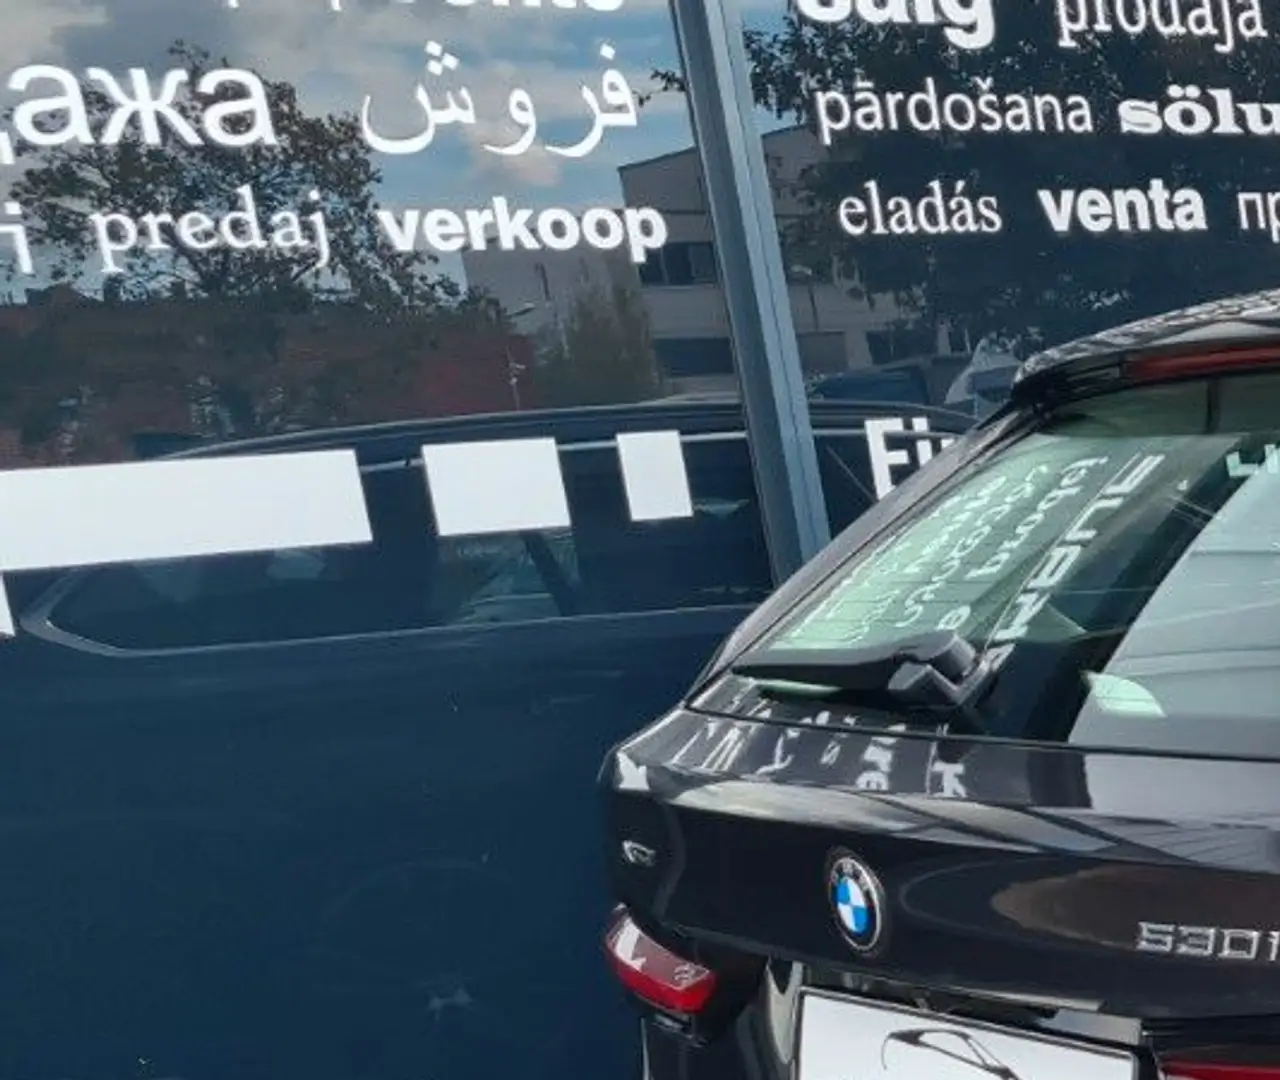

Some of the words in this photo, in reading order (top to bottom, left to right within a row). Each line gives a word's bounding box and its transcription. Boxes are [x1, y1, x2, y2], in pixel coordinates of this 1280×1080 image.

[815, 78, 1093, 146] pārdošana
[88, 184, 331, 273] predaj
[375, 196, 668, 263] verkoop
[838, 180, 1003, 236] eladás
[1037, 179, 1208, 232] venta
